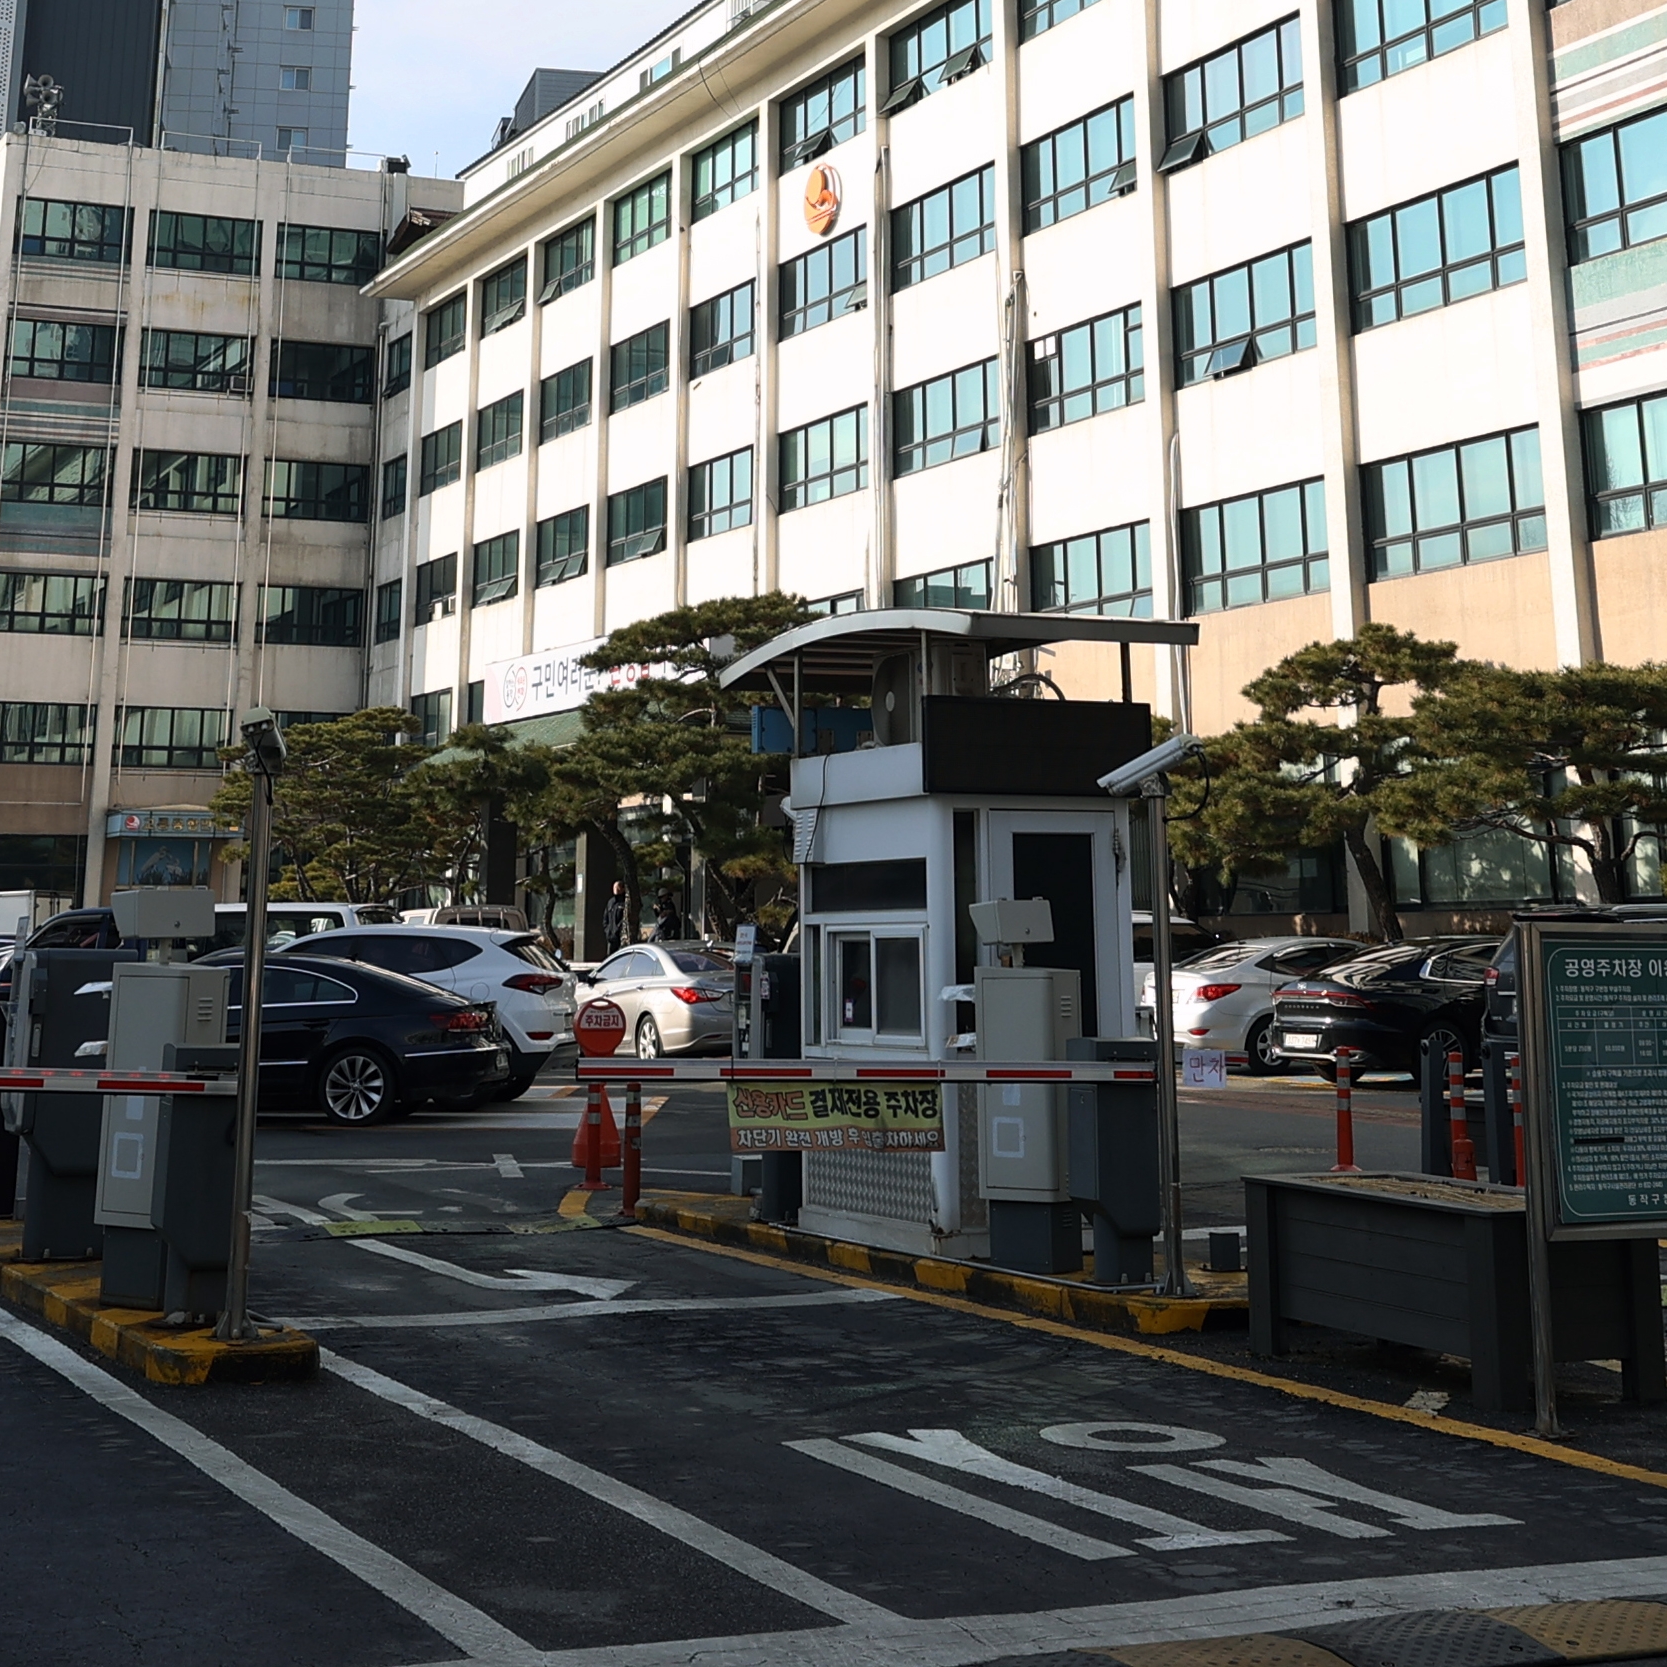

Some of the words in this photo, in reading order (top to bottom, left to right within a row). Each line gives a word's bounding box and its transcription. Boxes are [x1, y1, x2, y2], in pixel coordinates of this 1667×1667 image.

[1564, 958, 1643, 978] 공영주차장
[585, 1014, 619, 1027] 주차금지
[1189, 1052, 1225, 1083] 만차
[733, 1087, 809, 1121] 신용카드
[808, 1087, 881, 1119] 결제전용
[883, 1088, 939, 1120] 주차장
[737, 1128, 782, 1148] 차단기
[785, 1130, 813, 1148] 완전
[815, 1128, 844, 1148] 개방
[847, 1127, 861, 1145] 후
[861, 1129, 940, 1149] 입출차하세요
